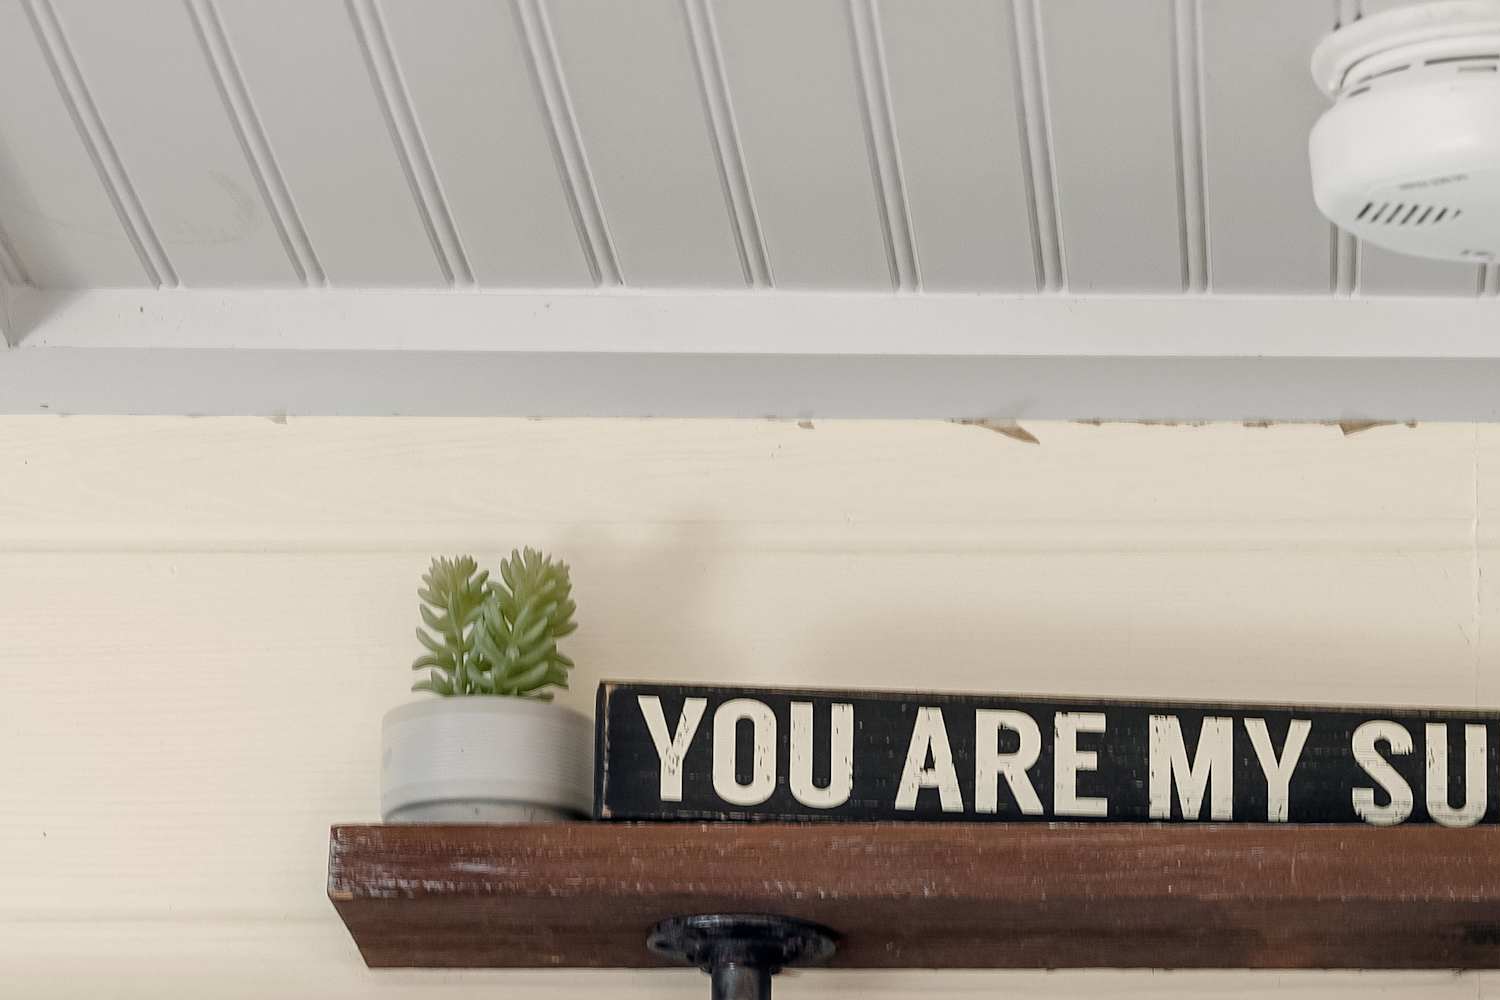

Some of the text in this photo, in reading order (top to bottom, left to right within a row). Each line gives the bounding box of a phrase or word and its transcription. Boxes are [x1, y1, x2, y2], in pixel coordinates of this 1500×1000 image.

[637, 695, 854, 809] YOU
[894, 705, 1109, 818] ARE
[1148, 713, 1312, 823] MY
